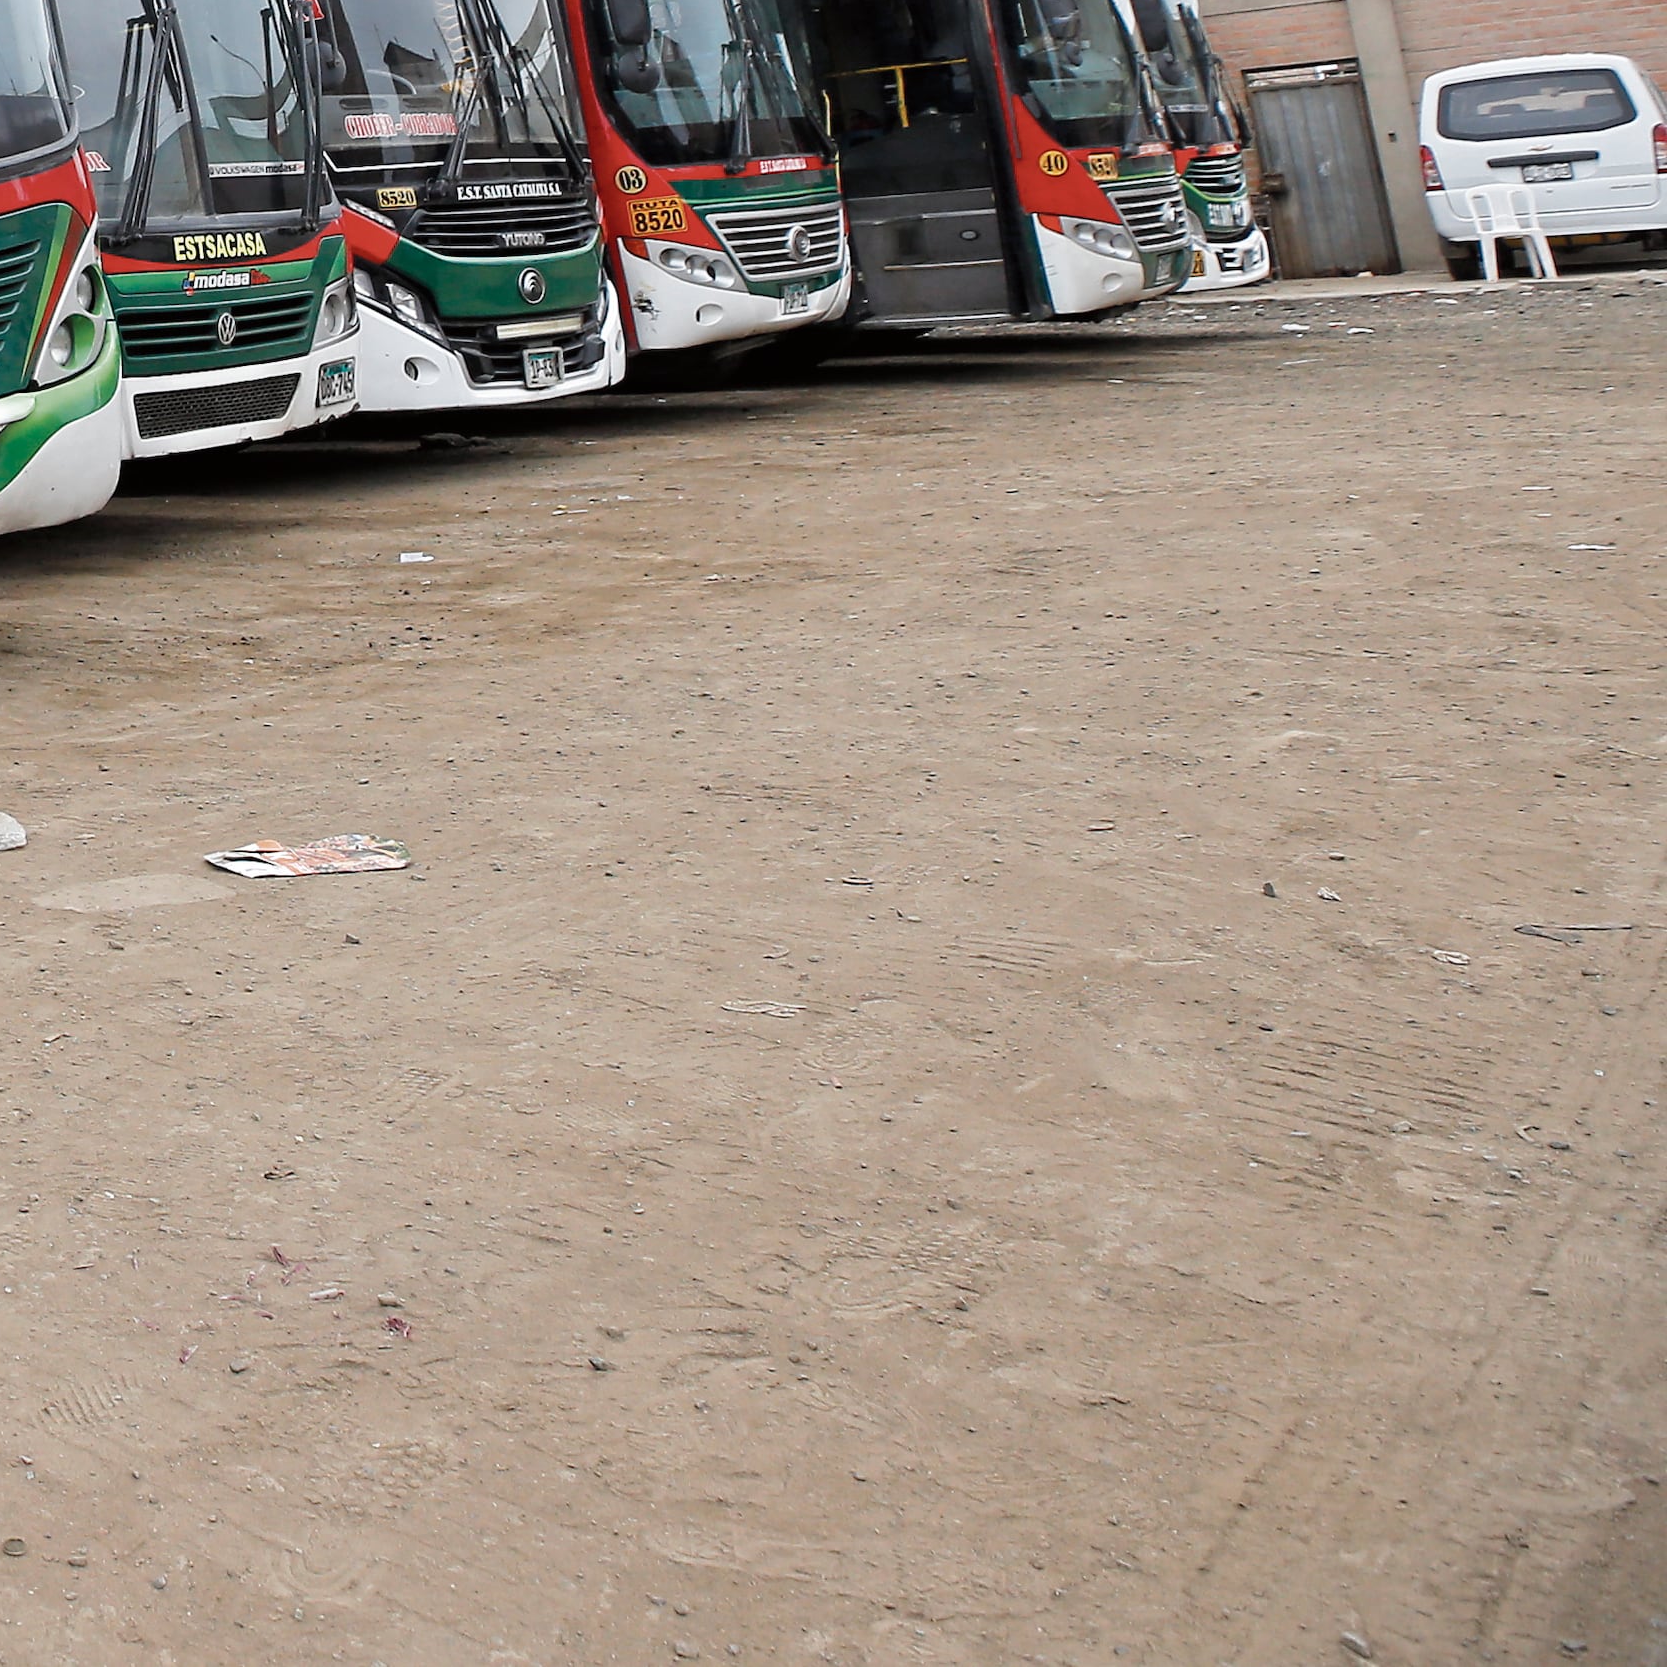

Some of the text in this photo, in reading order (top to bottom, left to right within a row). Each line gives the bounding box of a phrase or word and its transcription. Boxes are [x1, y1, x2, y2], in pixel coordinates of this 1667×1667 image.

[1042, 154, 1065, 172] 40
[618, 169, 643, 191] 03
[380, 190, 415, 207] 8520
[632, 200, 678, 210] RUTA
[634, 209, 683, 232] 8520
[173, 232, 267, 262] ESTSACASA
[502, 234, 545, 247] YUTONG
[193, 271, 251, 289] modasa
